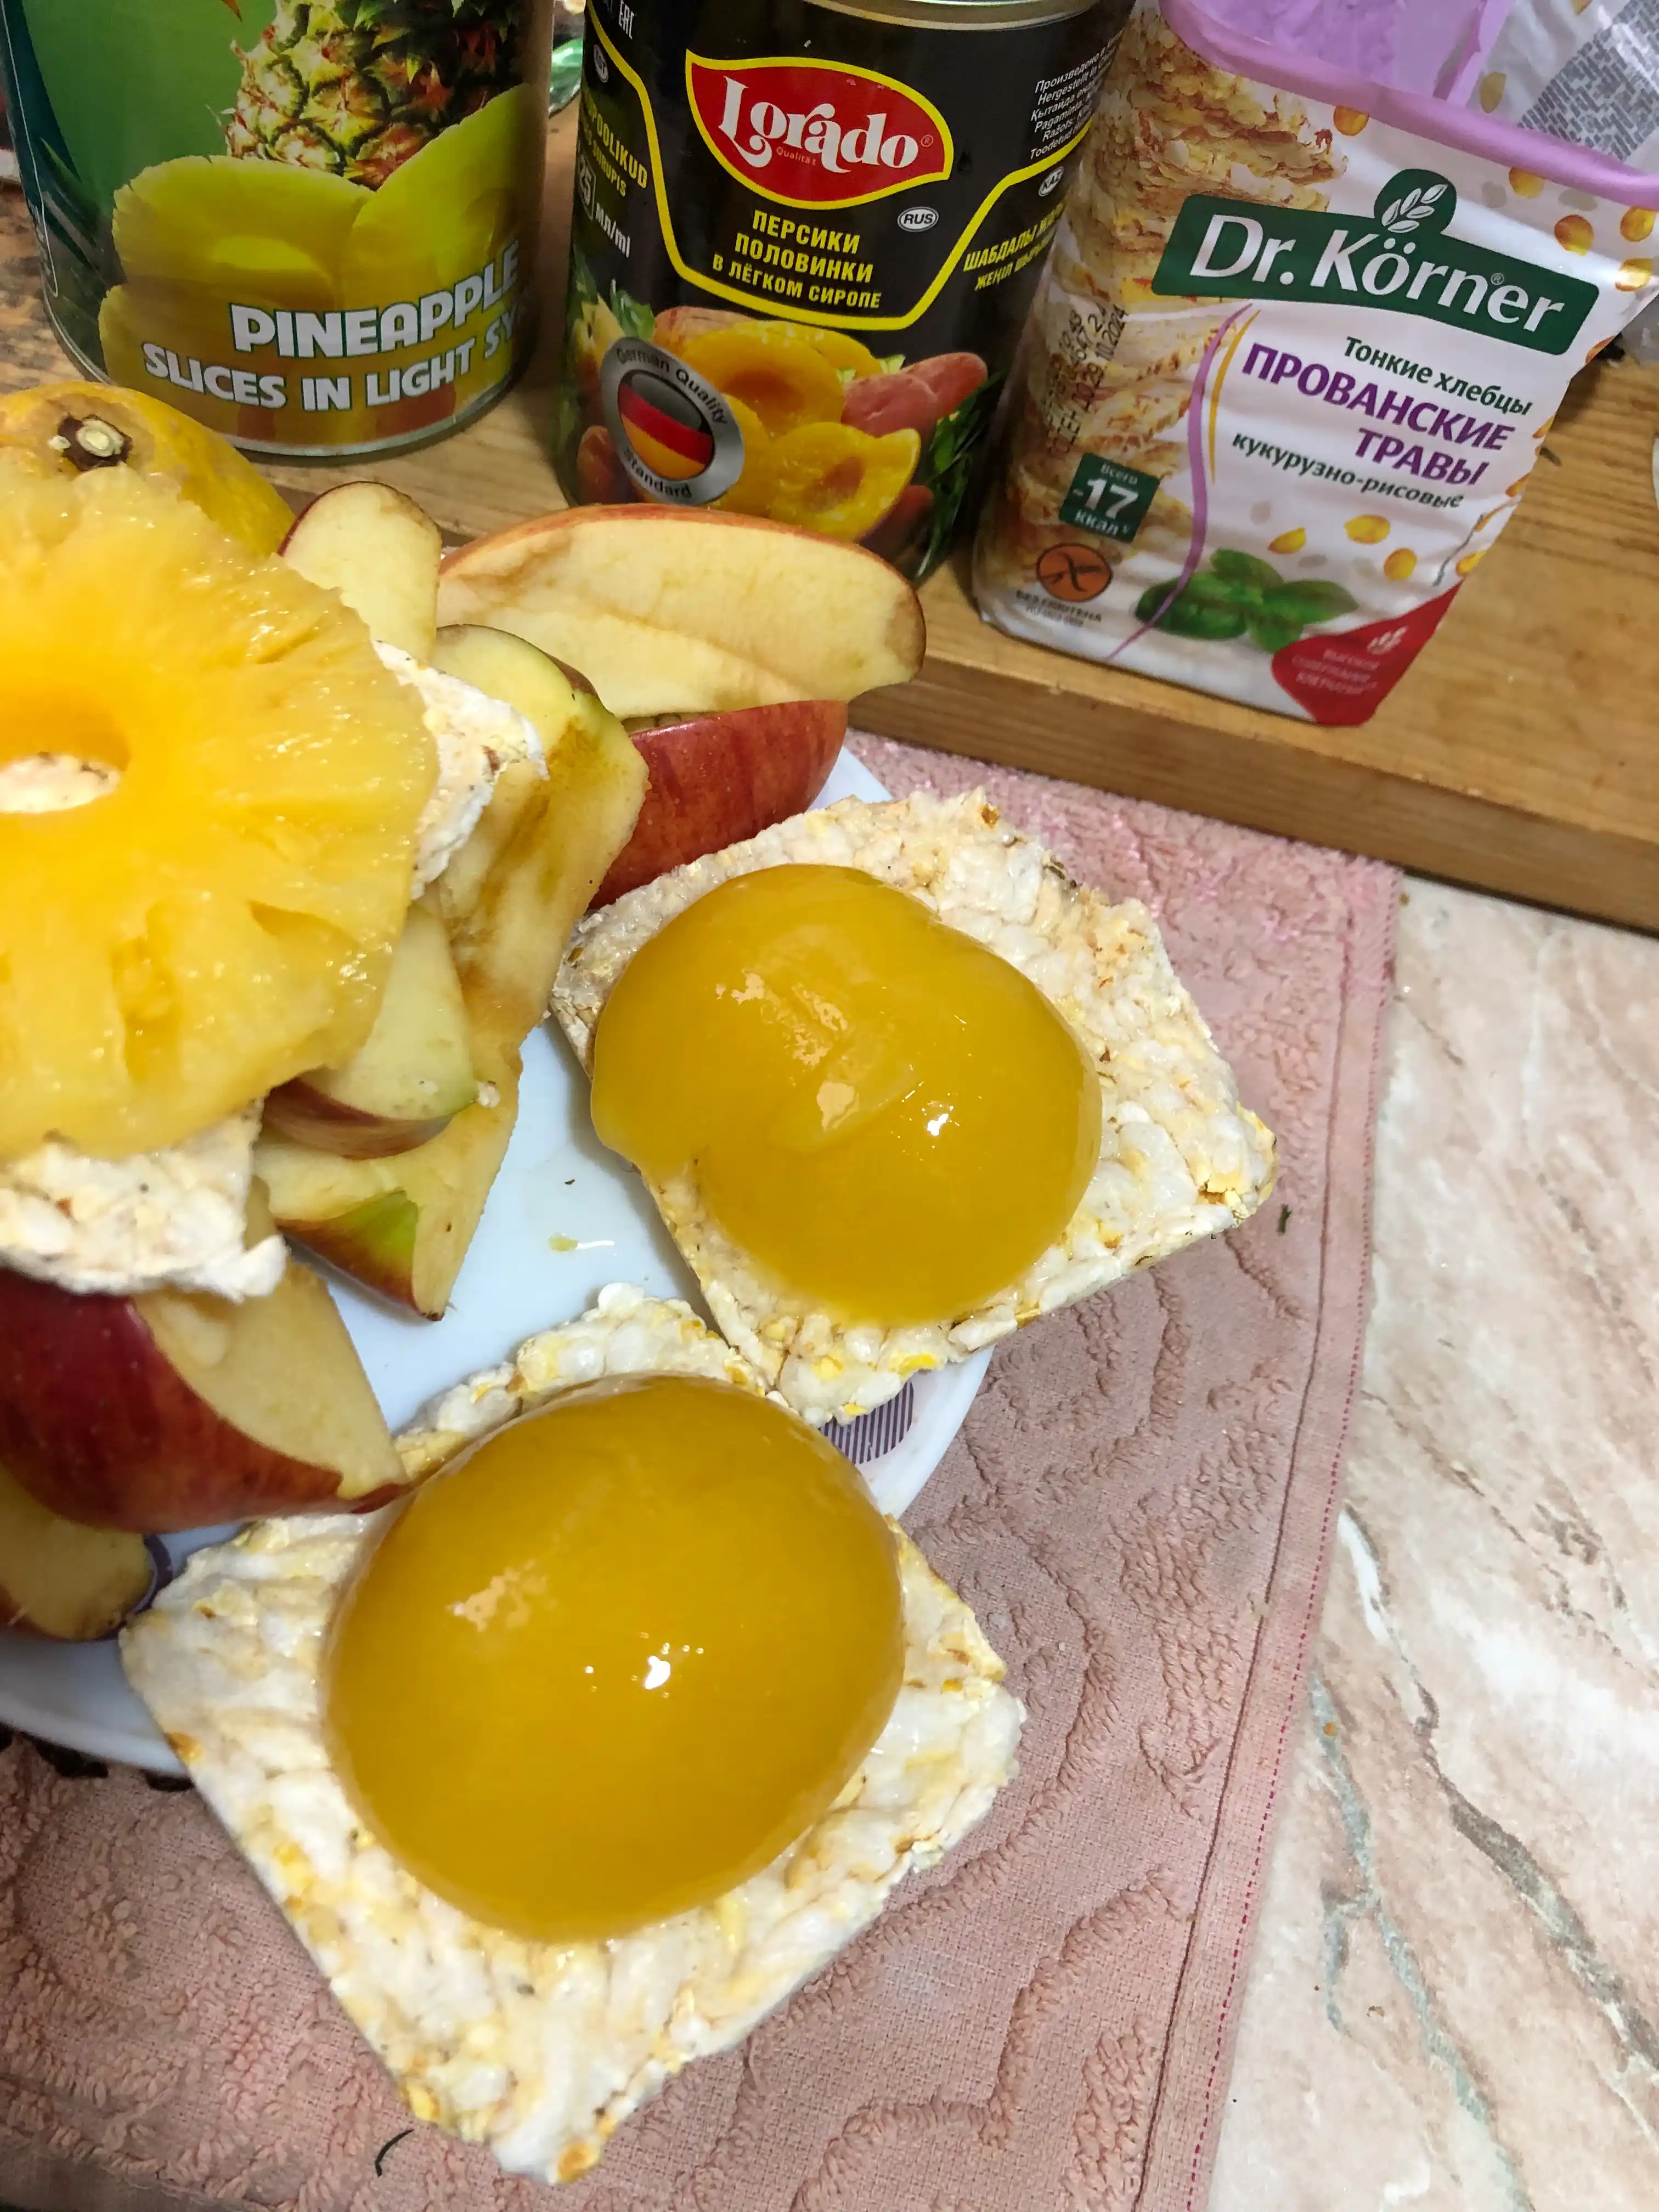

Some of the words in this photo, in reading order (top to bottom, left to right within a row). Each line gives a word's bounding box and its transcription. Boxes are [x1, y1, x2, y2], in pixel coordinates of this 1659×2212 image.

[1035, 52, 1099, 93] Произведено
[1038, 71, 1089, 105] Hergestellt
[718, 76, 918, 173] Lorado
[752, 210, 860, 255] ПЕРСИКИ
[903, 212, 933, 225] RUS
[735, 232, 874, 283] ПОЛОВИНКИ
[963, 224, 1038, 272] ШАБДАЛЫ
[1189, 214, 1296, 285] Dr.
[1310, 229, 1564, 332] Körner
[230, 238, 520, 358] PINEAPPLE
[712, 253, 724, 272] В
[728, 262, 803, 298] ЛЁГКОМ
[808, 285, 882, 308] СИРОПЕ
[142, 341, 287, 409] SLICES
[301, 375, 352, 411] IN
[365, 337, 476, 407] LIGHT
[676, 369, 729, 424] Quality
[1242, 342, 1516, 451] ПРОВАНСКИЕ
[1344, 335, 1432, 384] Тонкие
[1435, 371, 1533, 416] хлебцы
[623, 448, 693, 499] Standard
[1232, 432, 1465, 508] кукурузно-рисовые
[1354, 427, 1489, 486] ТРАВЫ
